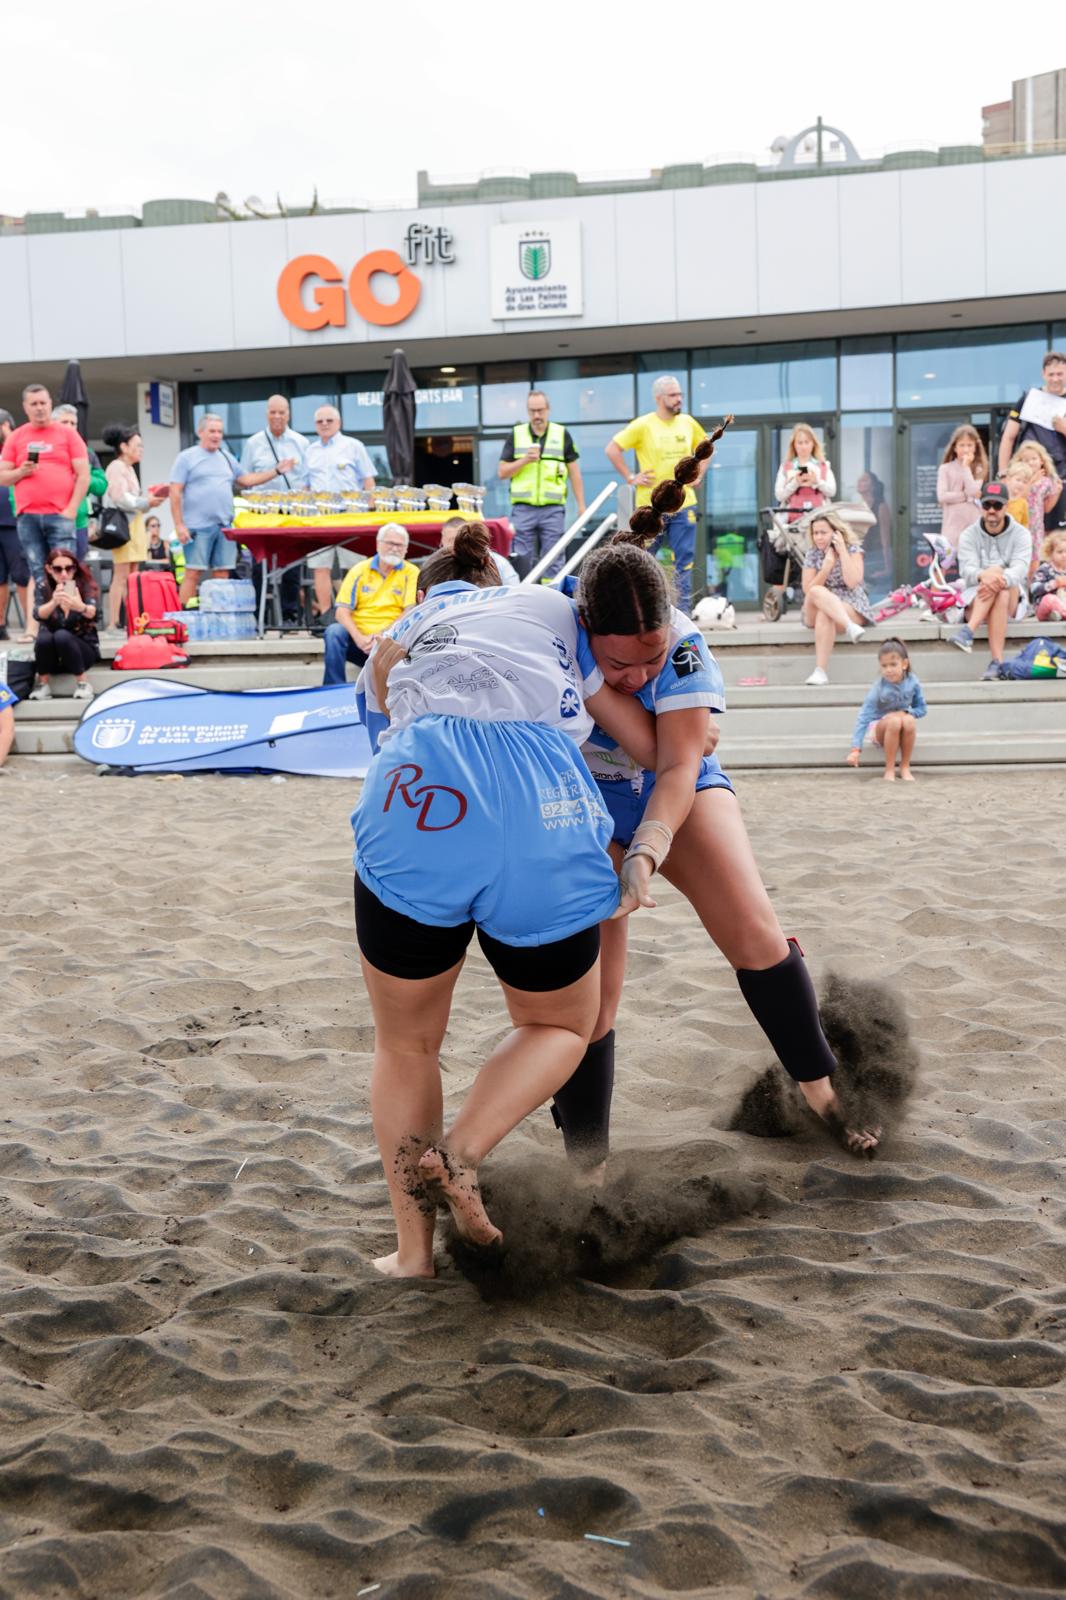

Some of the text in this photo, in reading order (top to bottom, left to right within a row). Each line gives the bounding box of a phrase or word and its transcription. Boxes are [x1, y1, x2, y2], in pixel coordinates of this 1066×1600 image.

[276, 223, 456, 331] GO fit
[505, 285, 567, 294] Ayuntamiento
[505, 295, 516, 303] de
[505, 301, 567, 312] de Gran Canaria
[442, 388, 463, 402] BAR
[139, 731, 158, 739] de
[194, 735, 245, 744] Canaria
